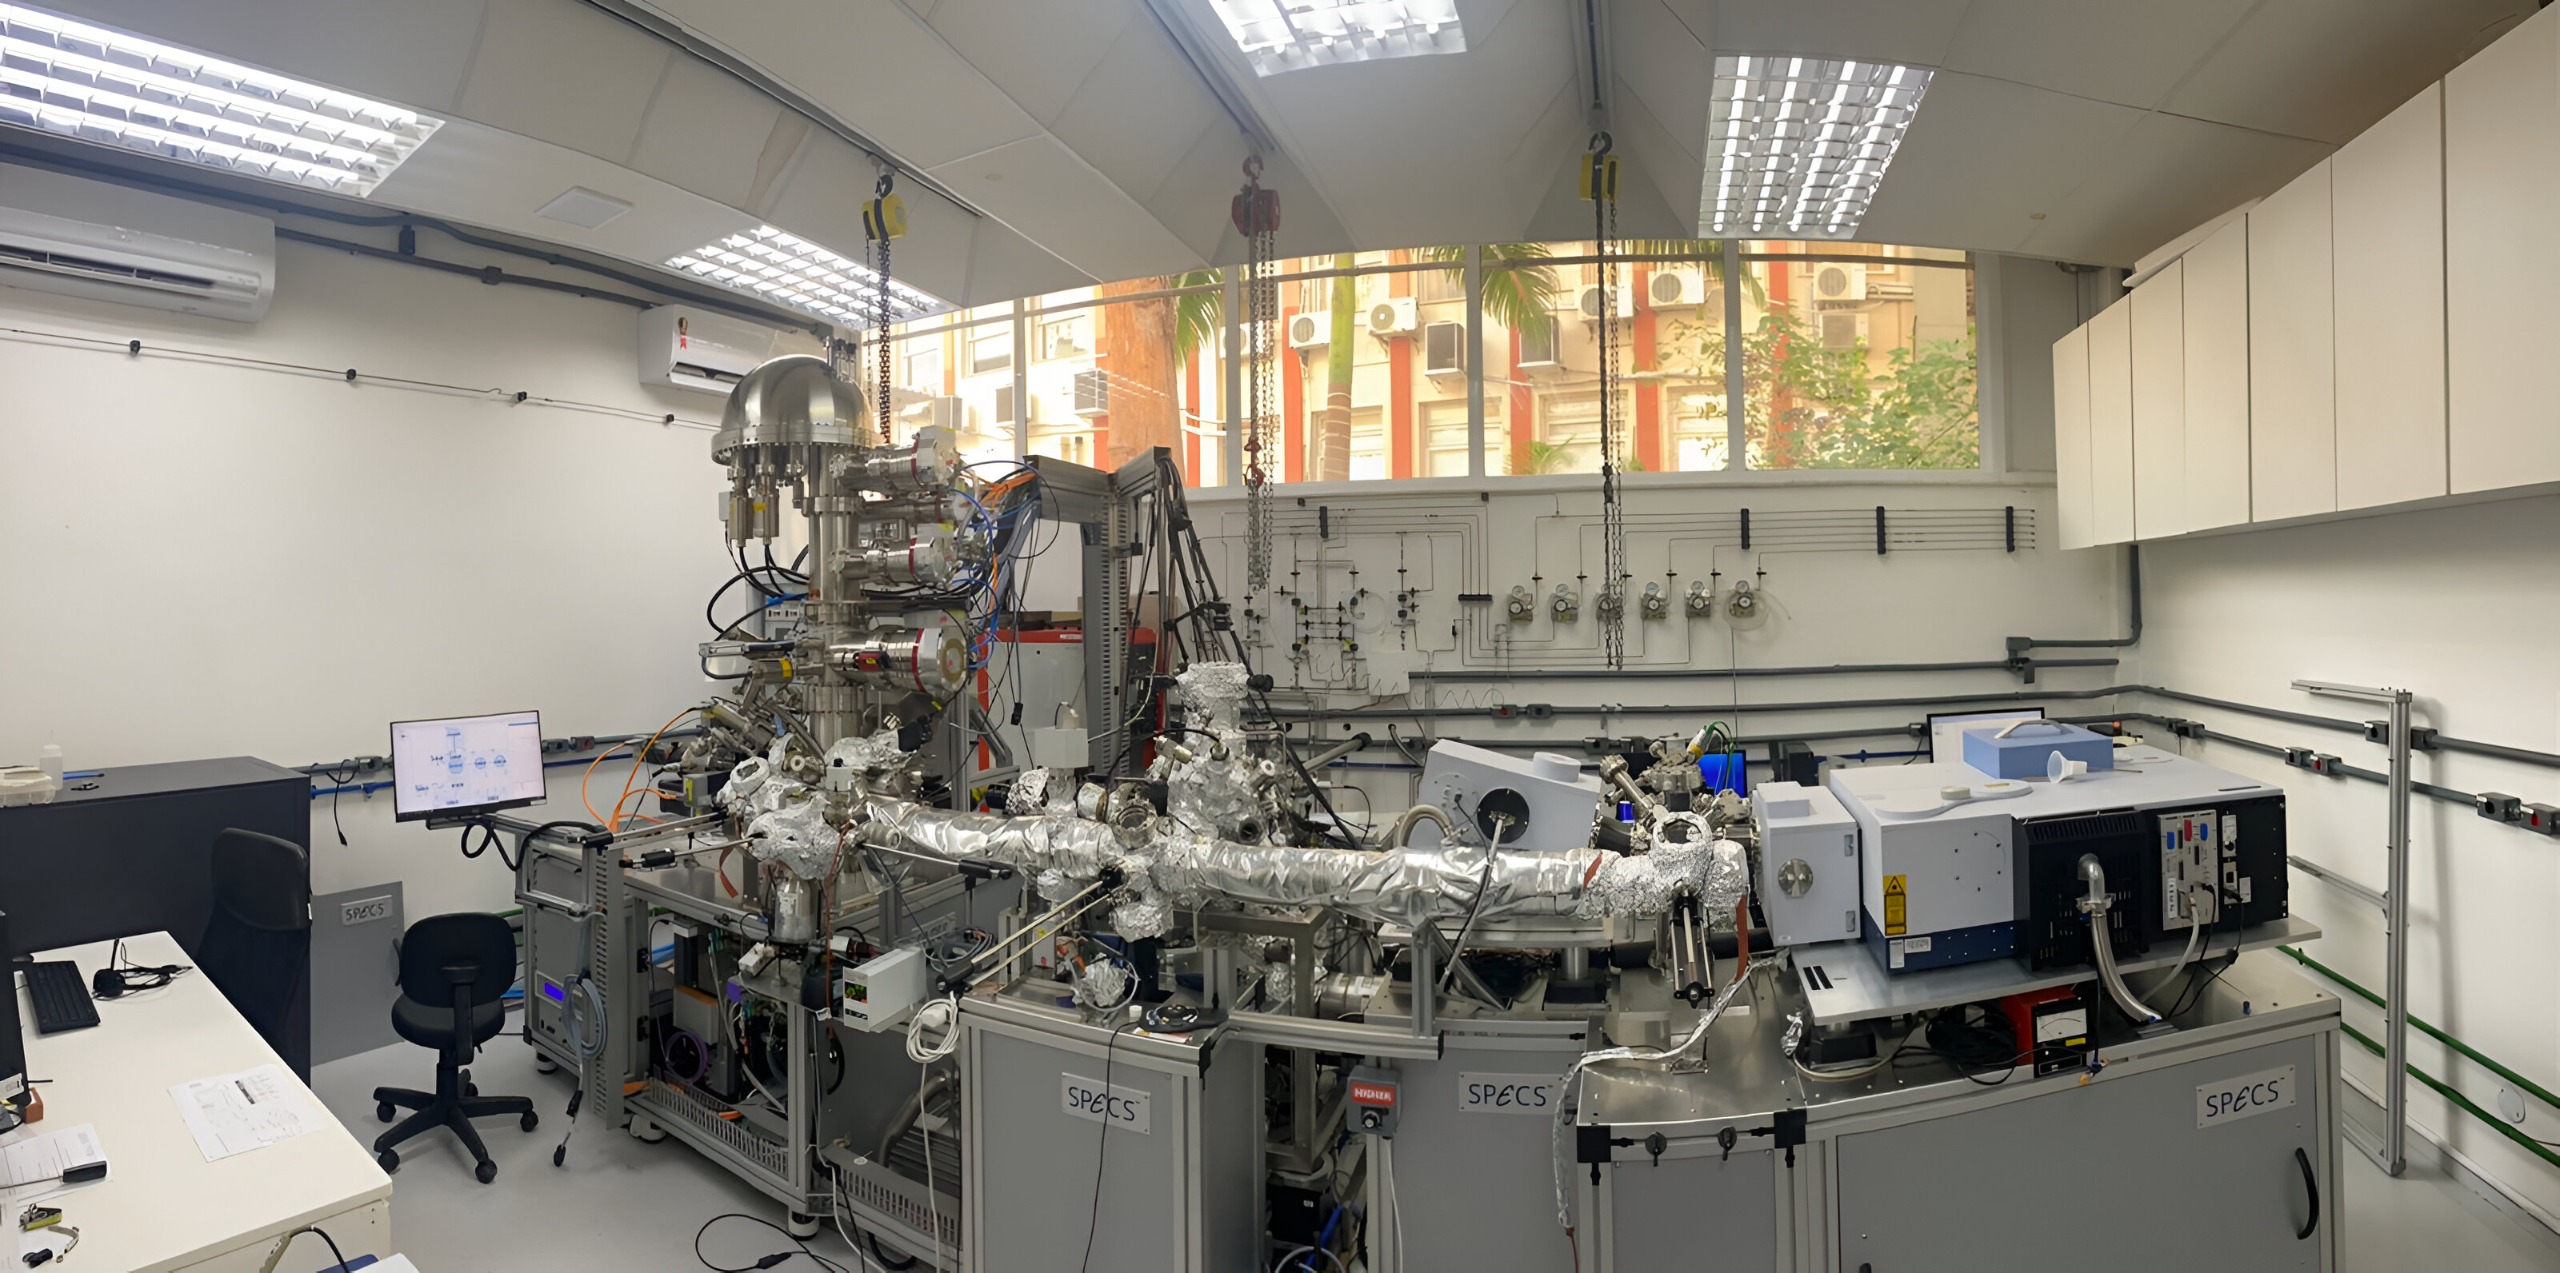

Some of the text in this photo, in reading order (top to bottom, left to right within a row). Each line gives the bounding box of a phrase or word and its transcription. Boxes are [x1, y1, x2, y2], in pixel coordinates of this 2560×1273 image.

[345, 903, 384, 921] SPECS
[1068, 1086, 1135, 1121] SPECS
[1468, 1083, 1547, 1107] SPECS
[2206, 1080, 2279, 1117] SPECS
